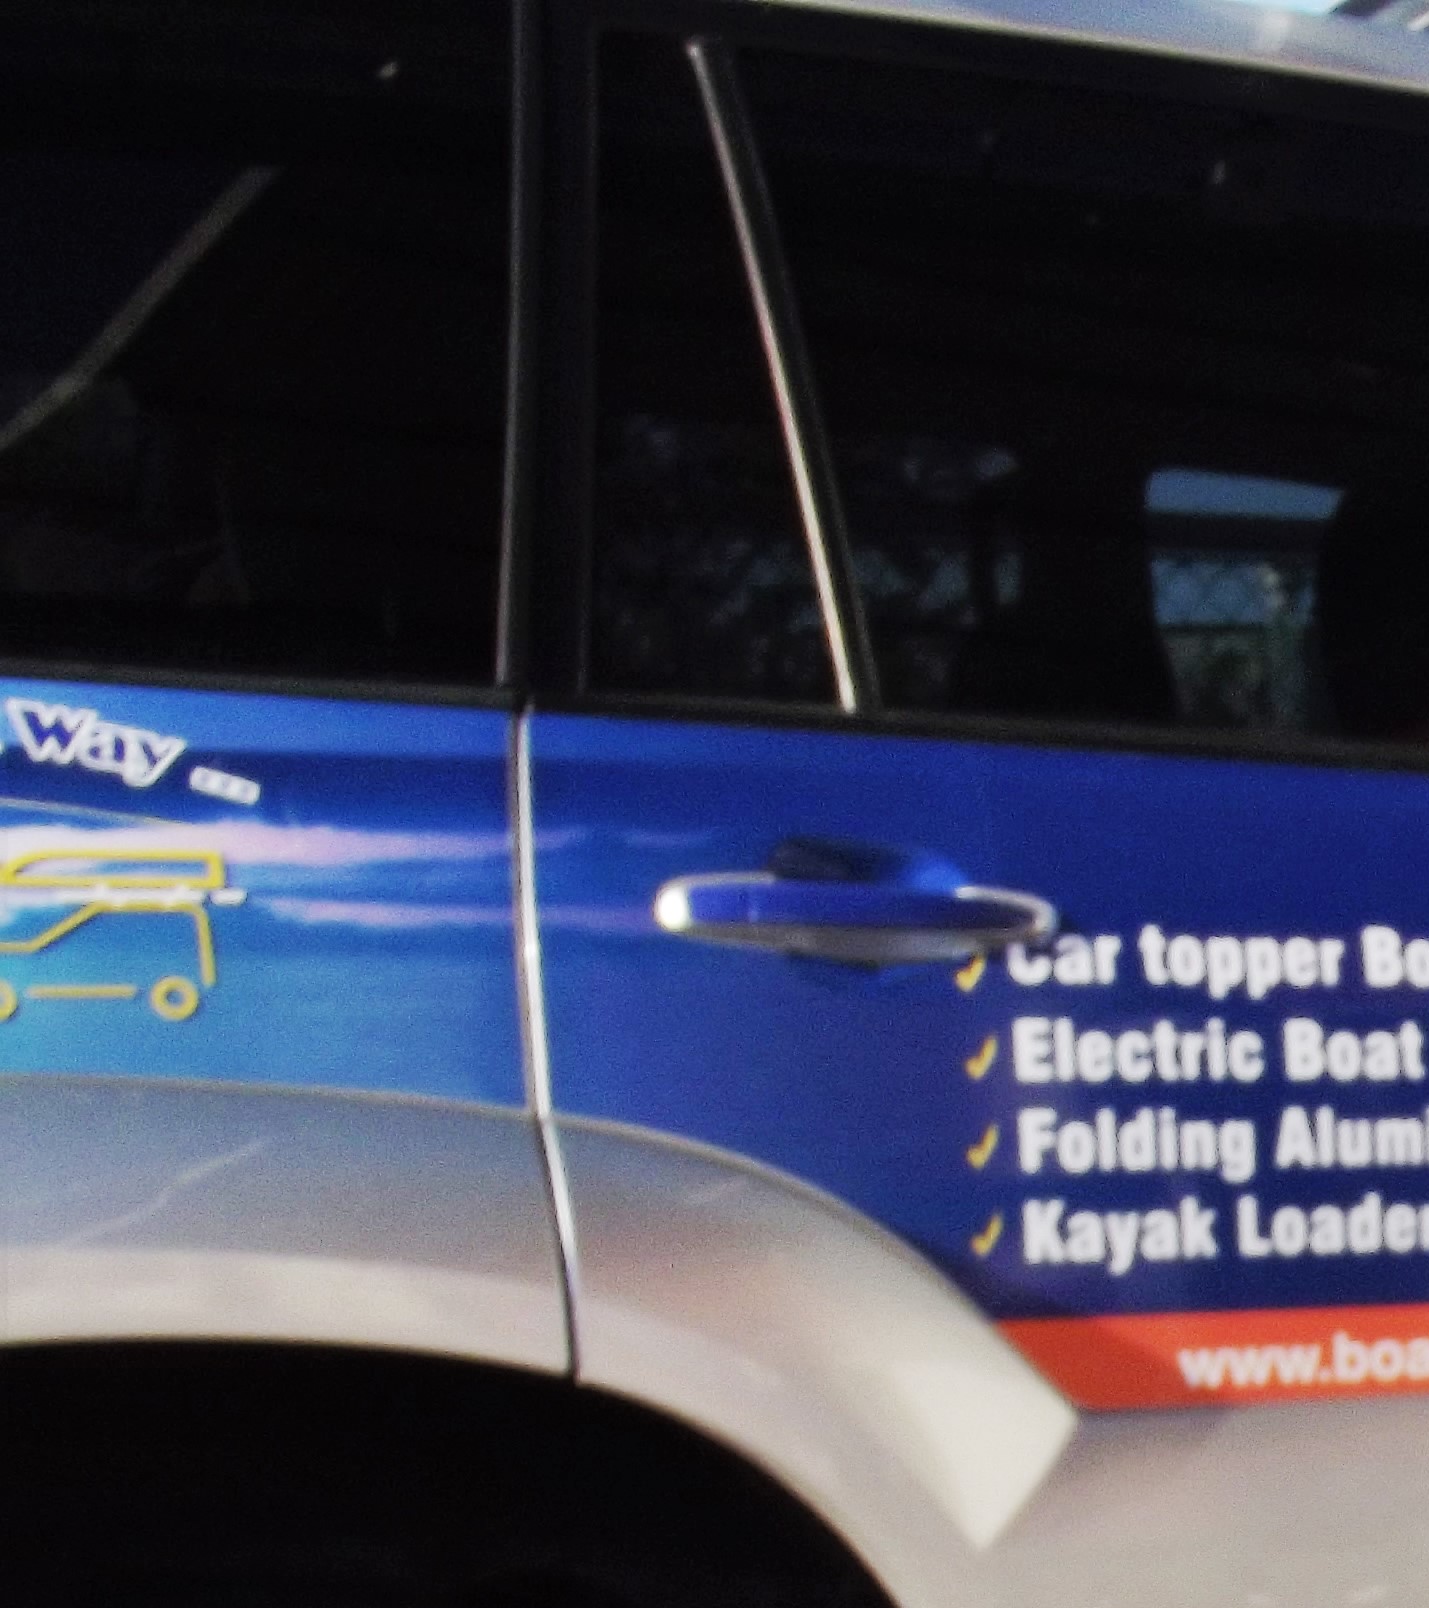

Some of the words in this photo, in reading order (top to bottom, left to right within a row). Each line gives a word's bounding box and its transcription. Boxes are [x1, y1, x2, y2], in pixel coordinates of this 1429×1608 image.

[1006, 933, 1122, 987] Car
[1138, 924, 1344, 999] topper
[1011, 1016, 1264, 1084] Electric
[1283, 1017, 1424, 1081] Boat
[1016, 1106, 1256, 1183] Folding
[1022, 1197, 1217, 1275] Kayak
